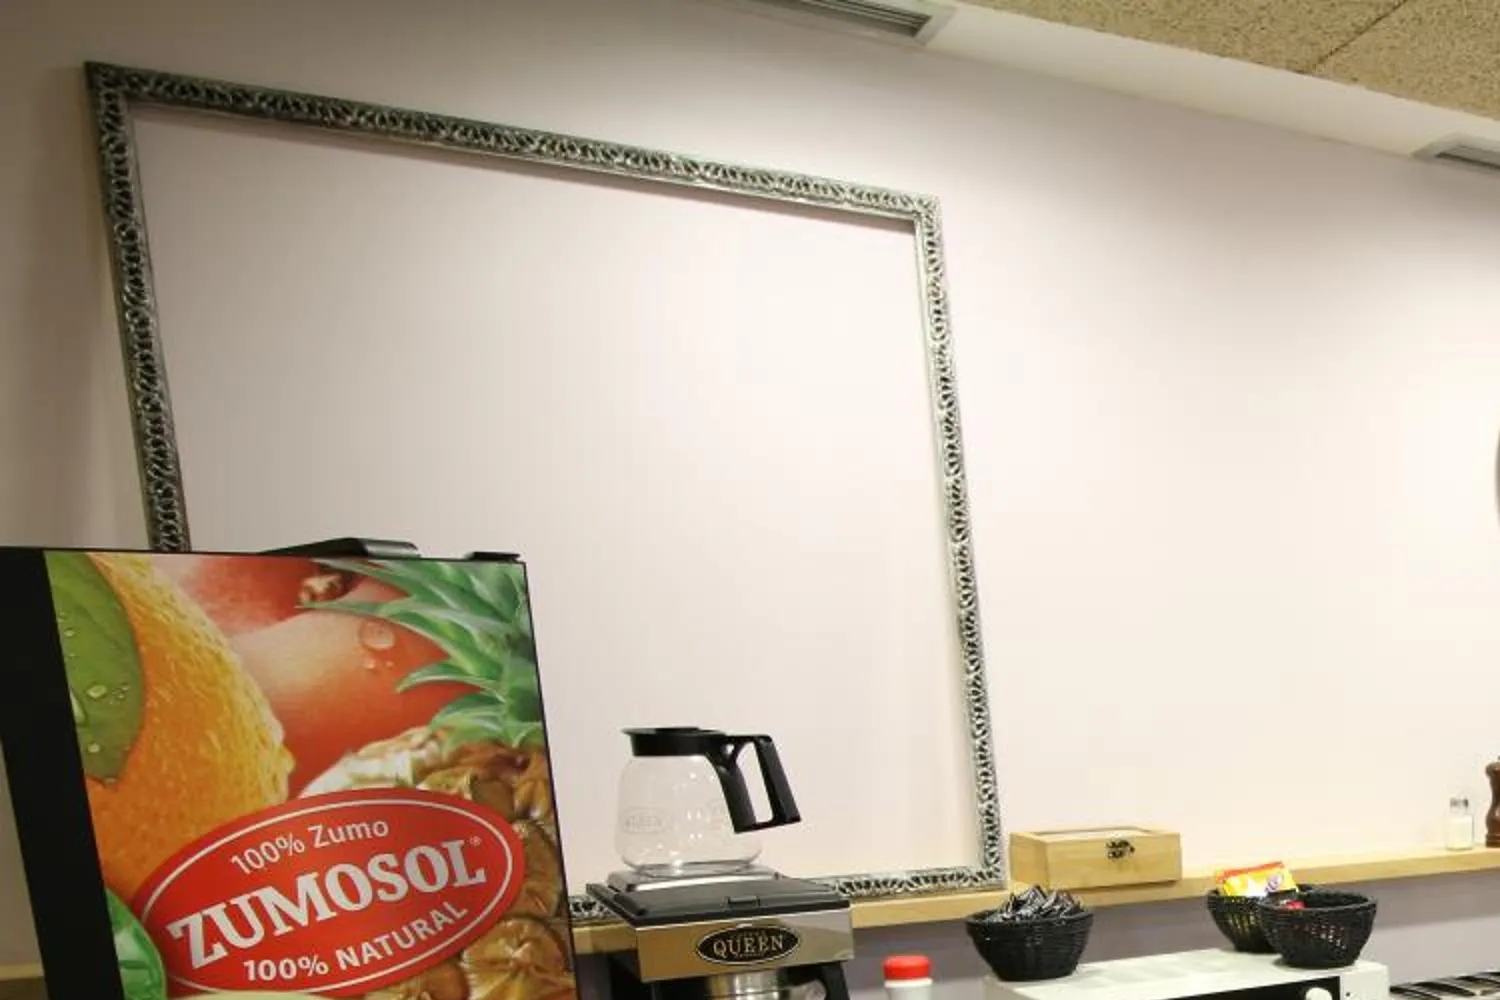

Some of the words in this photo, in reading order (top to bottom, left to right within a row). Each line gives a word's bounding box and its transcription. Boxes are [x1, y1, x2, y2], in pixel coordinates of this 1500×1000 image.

[231, 832, 305, 876] 100%
[307, 818, 389, 849] Zumo
[244, 954, 329, 982] 100%
[335, 900, 469, 971] NATURAL
[713, 935, 783, 958] QUEEN
